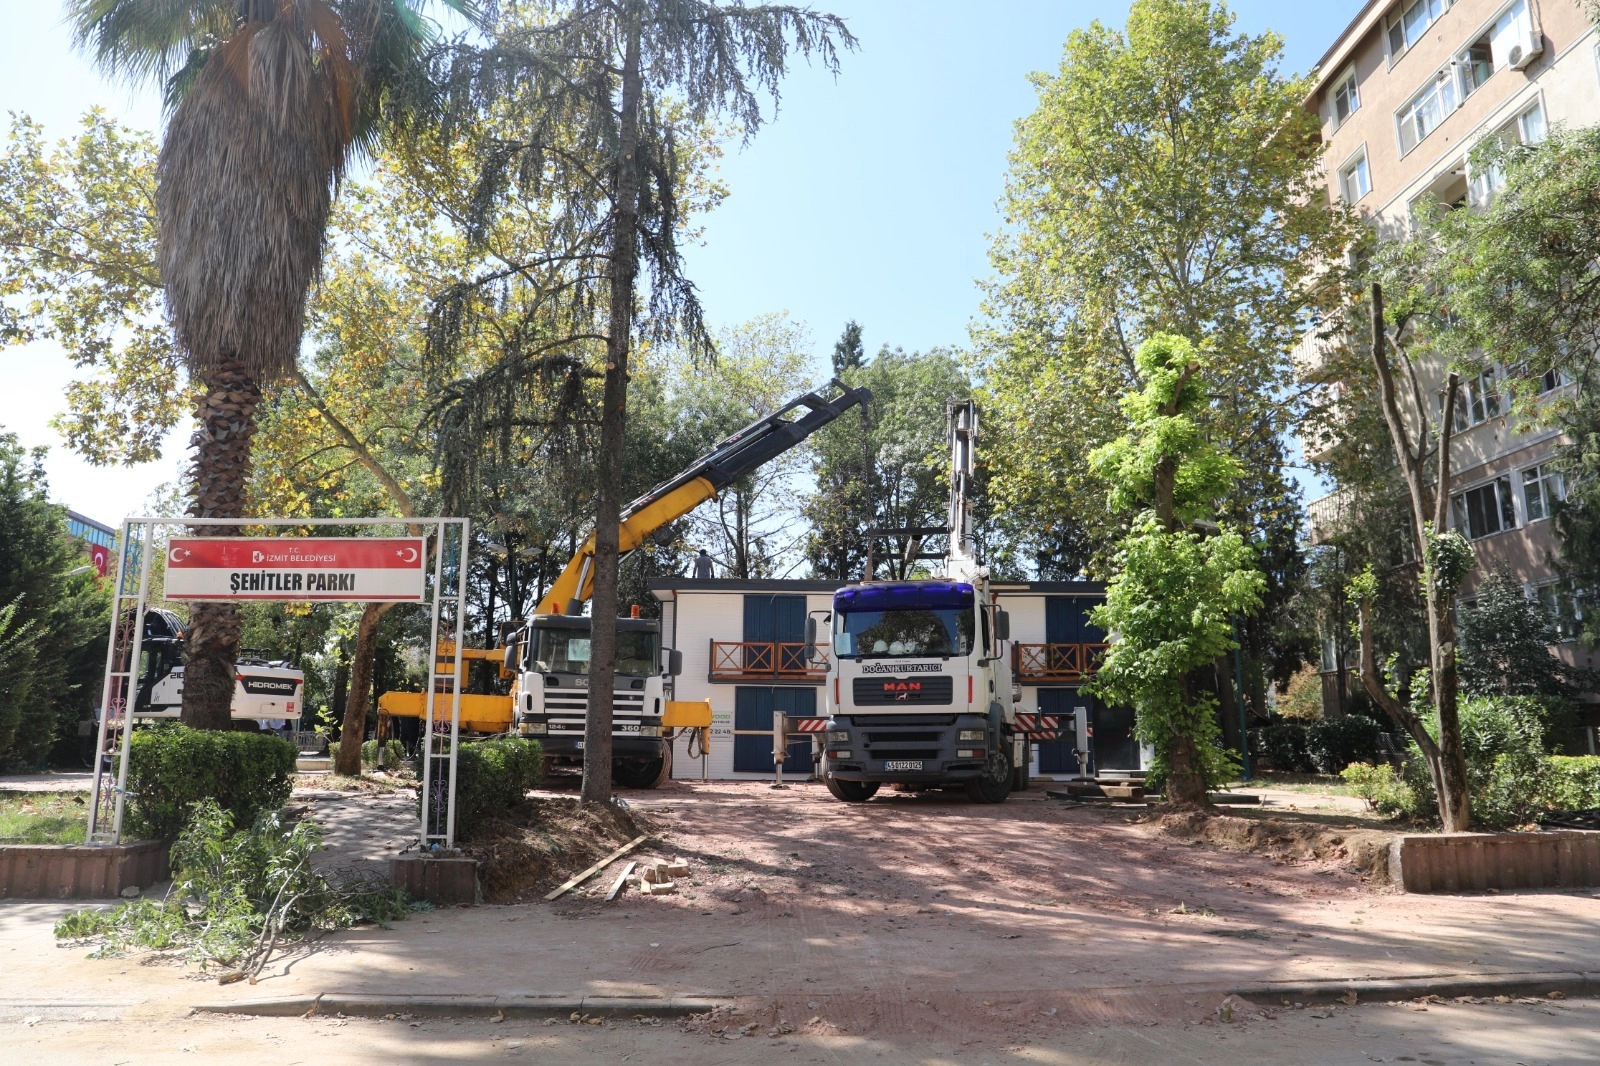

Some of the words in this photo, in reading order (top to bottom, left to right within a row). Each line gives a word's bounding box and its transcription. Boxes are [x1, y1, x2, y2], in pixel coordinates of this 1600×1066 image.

[266, 554, 288, 562] İZMİT
[290, 554, 336, 562] BELEDİYESİ
[230, 570, 302, 594] ŞEHİTLER
[306, 573, 355, 591] PARKI
[862, 662, 893, 674] DOĞAN
[894, 664, 943, 673] KURTARICI
[883, 682, 921, 691] MAN
